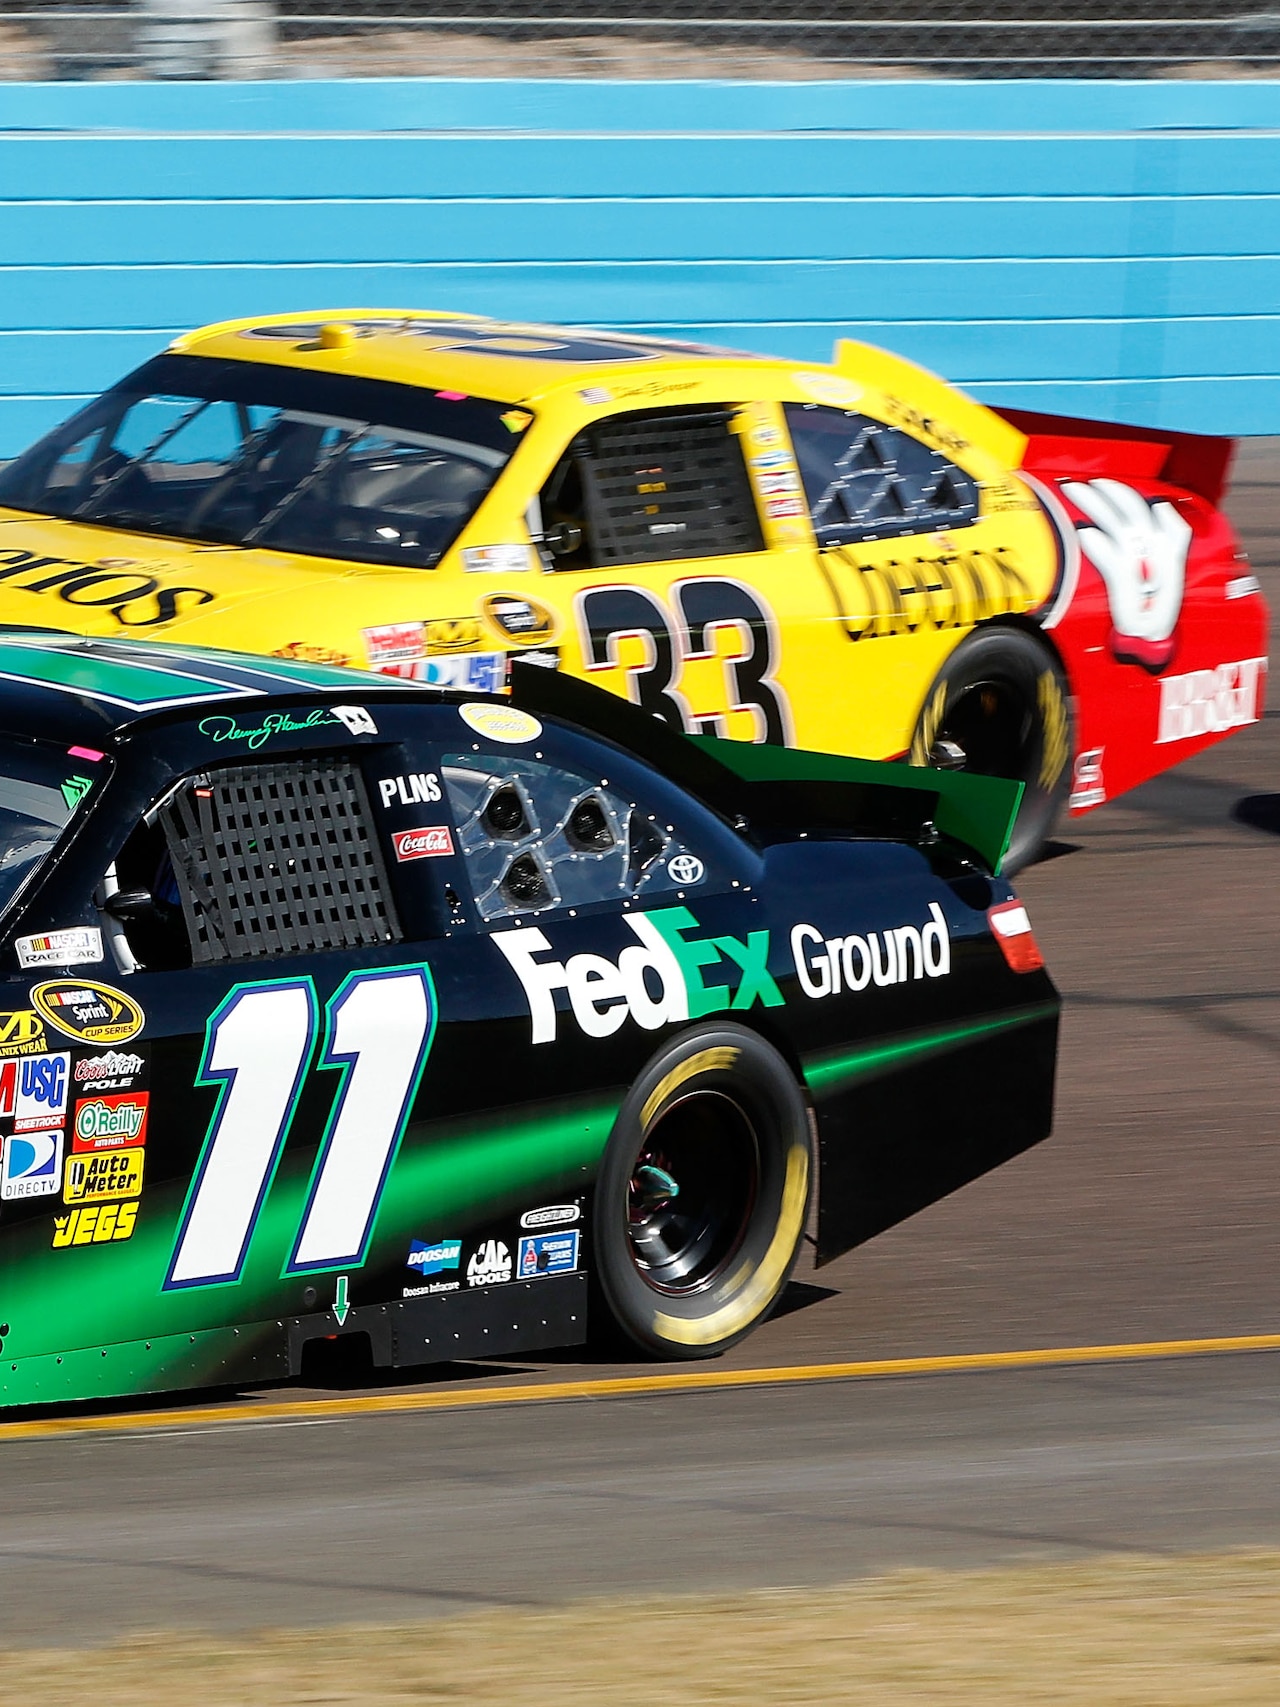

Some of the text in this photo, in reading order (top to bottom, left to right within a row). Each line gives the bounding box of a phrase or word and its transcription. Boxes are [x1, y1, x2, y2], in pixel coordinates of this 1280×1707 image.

[575, 575, 797, 749] 33
[378, 773, 442, 808] PLNS
[25, 950, 64, 963] RACE
[490, 902, 951, 1044] FedEx Ground
[72, 1003, 110, 1024] Sprint
[85, 1025, 134, 1037] CUP SERIES
[18, 1037, 49, 1056] WEAR
[74, 1058, 145, 1081] Coors LIGHT
[21, 1056, 66, 1108] USG
[82, 1077, 134, 1091] POLE
[14, 1115, 65, 1131] SHEETROCK
[80, 1103, 142, 1136] O'Reilly
[164, 963, 439, 1292] 11
[88, 1156, 130, 1175] Auto
[6, 1180, 55, 1197] DIRECTV
[84, 1174, 137, 1194] Meter
[52, 1201, 140, 1248] JEGS
[407, 1245, 461, 1266] DOOSAN
[467, 1239, 513, 1276] MAC
[466, 1270, 512, 1287] TOOLS
[402, 1286, 429, 1298] Doosan
